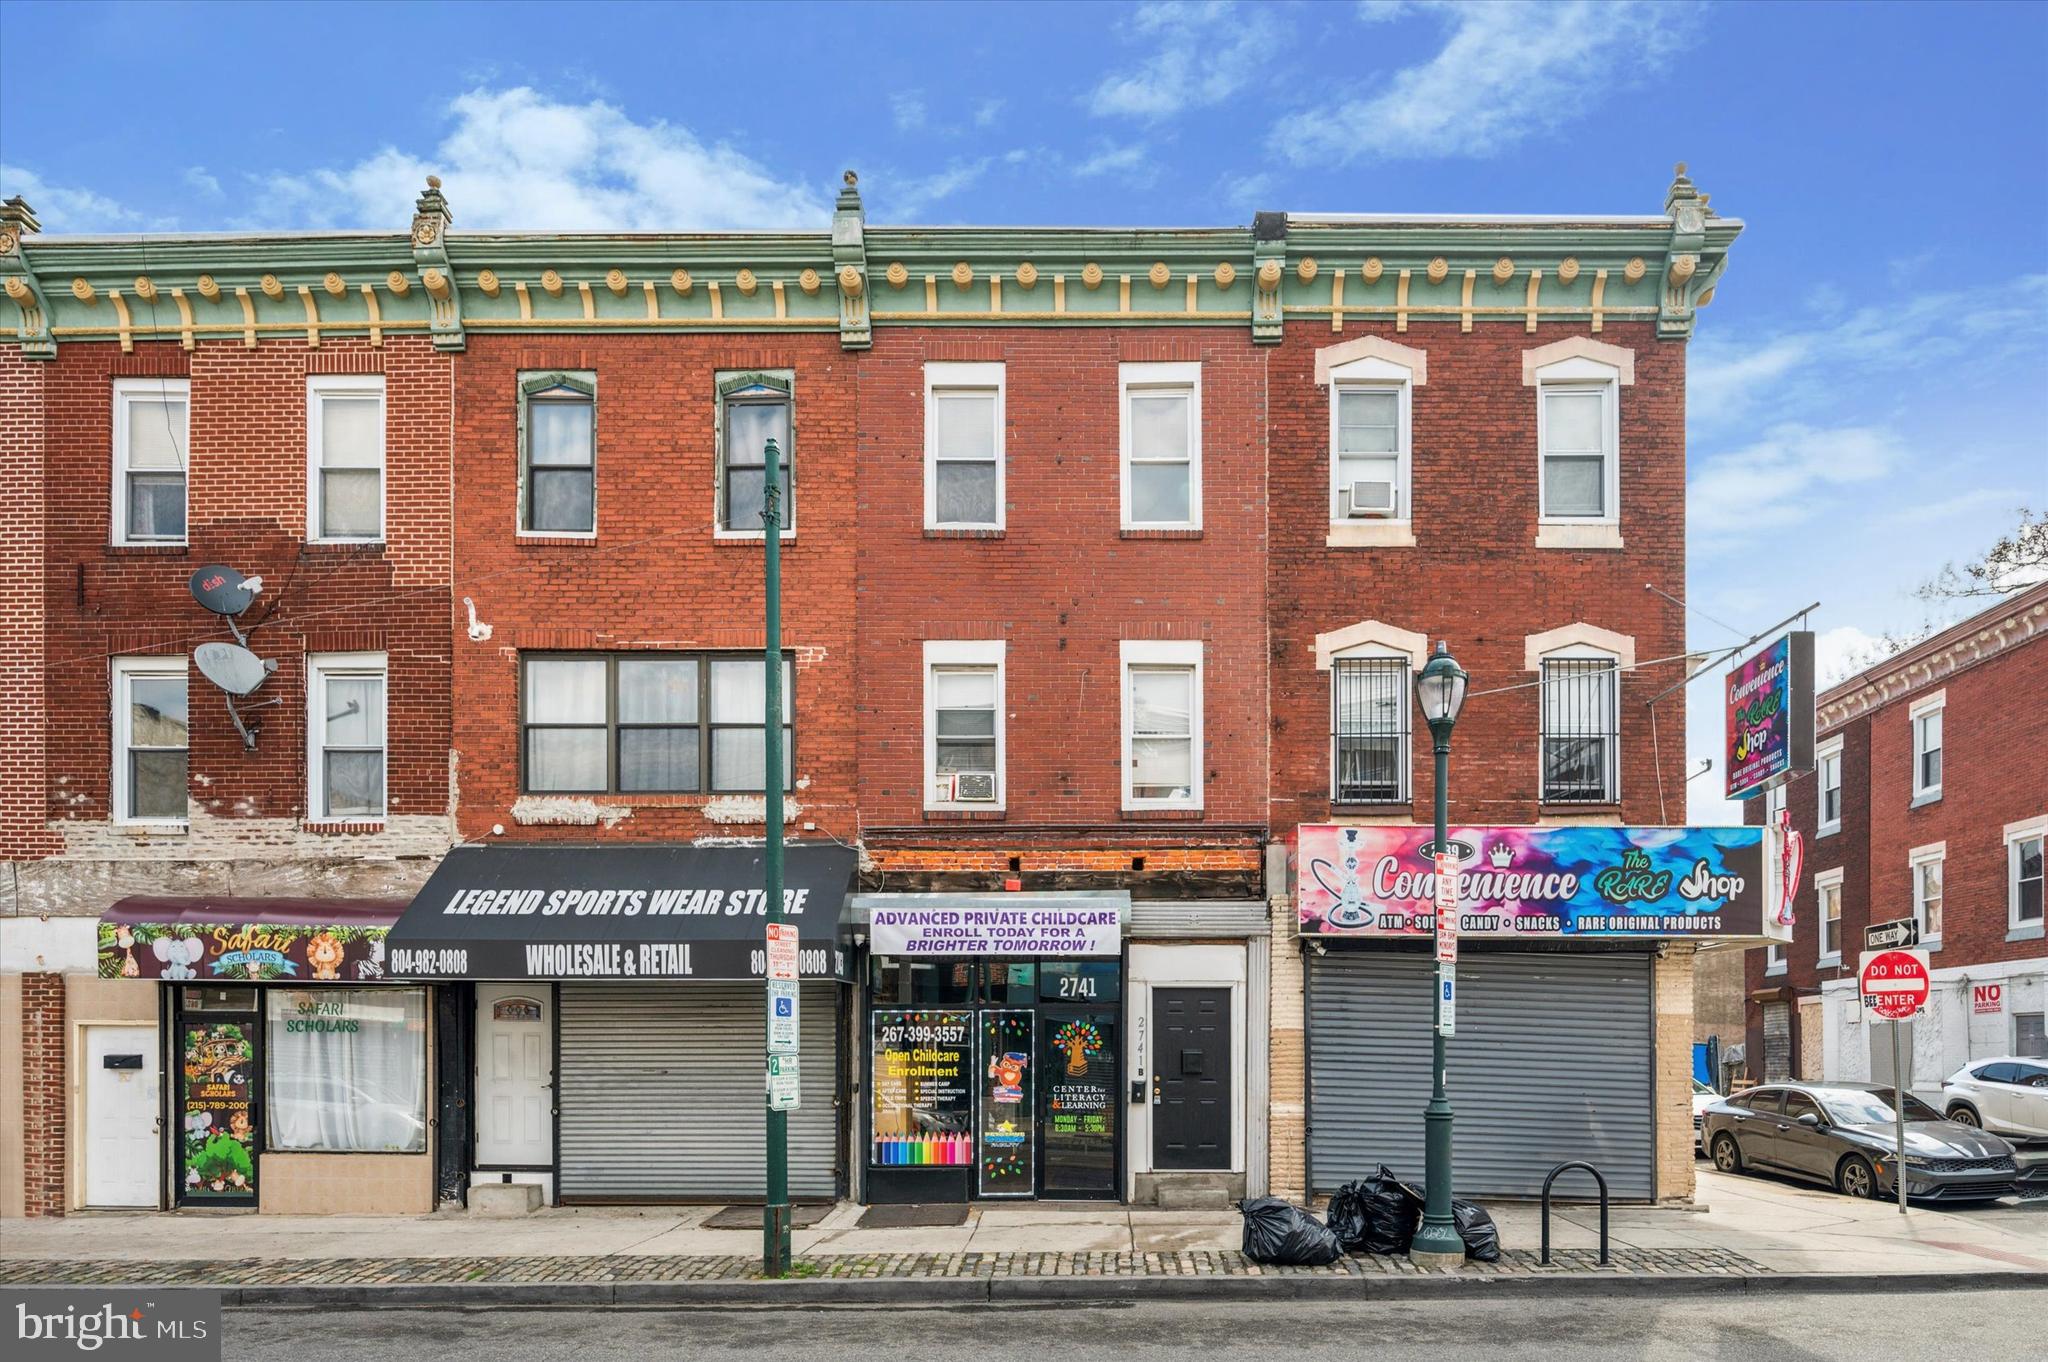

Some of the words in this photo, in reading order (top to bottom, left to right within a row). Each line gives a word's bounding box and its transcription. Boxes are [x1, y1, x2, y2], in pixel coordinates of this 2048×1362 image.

[202, 575, 226, 592] dish
[1730, 660, 1784, 703] Convenience
[1737, 728, 1767, 761] Shop
[1761, 749, 1782, 765] PRODUCTS
[1624, 851, 1648, 869] The
[1374, 856, 1579, 900] Conenience
[1599, 871, 1667, 900] RARE
[1680, 861, 1745, 900] Shop
[443, 889, 545, 915] LEGEND
[542, 889, 647, 916] SPORTS
[647, 889, 729, 915] WEAR
[875, 912, 960, 925] ADVANCED
[964, 912, 1027, 925] PRIVATE
[1031, 912, 1116, 925] CHILDCARE
[1379, 915, 1403, 929] ATM
[1415, 916, 1436, 929] SOD
[1462, 917, 1499, 930] CANDY
[1516, 917, 1559, 930] SNACKS
[1578, 917, 1605, 930] RARE
[1609, 917, 1659, 930] ORIGINAL
[1664, 917, 1721, 930] PRODUCTS
[768, 926, 779, 938] NO
[922, 928, 982, 938] ENROLL
[987, 928, 1034, 938] TODAY
[1041, 928, 1070, 938] FOR
[1075, 928, 1085, 938] A
[1869, 933, 1884, 945] ONE
[1885, 930, 1899, 941] WAY
[210, 926, 294, 956] Safari
[906, 940, 988, 952] BRIGHTER
[993, 940, 1087, 952] TOMORROW
[226, 953, 277, 964] SCHOLARS
[391, 949, 468, 974] 804-982-0808
[525, 944, 621, 976] WHOLESALE
[624, 949, 637, 975] &
[639, 944, 693, 975] RETAIL
[1871, 965, 1888, 976] DO
[1894, 964, 1918, 976] NOT
[1060, 977, 1097, 997] 2741
[1974, 984, 2001, 1001] NO
[1877, 994, 1915, 1006] ENTER
[298, 1002, 344, 1016] SAFARI
[286, 1019, 359, 1033] SCHOLARS
[882, 1026, 965, 1042] 267-399-3557
[884, 1048, 910, 1064] Open
[913, 1048, 960, 1062] Childcare
[772, 1058, 779, 1074] 2
[888, 1066, 959, 1077] Enrollment
[200, 1090, 236, 1098] SCHOLARS
[206, 1083, 230, 1092] SAFARI
[1053, 1085, 1097, 1093] CENTER
[1054, 1115, 1078, 1123] MONDAY
